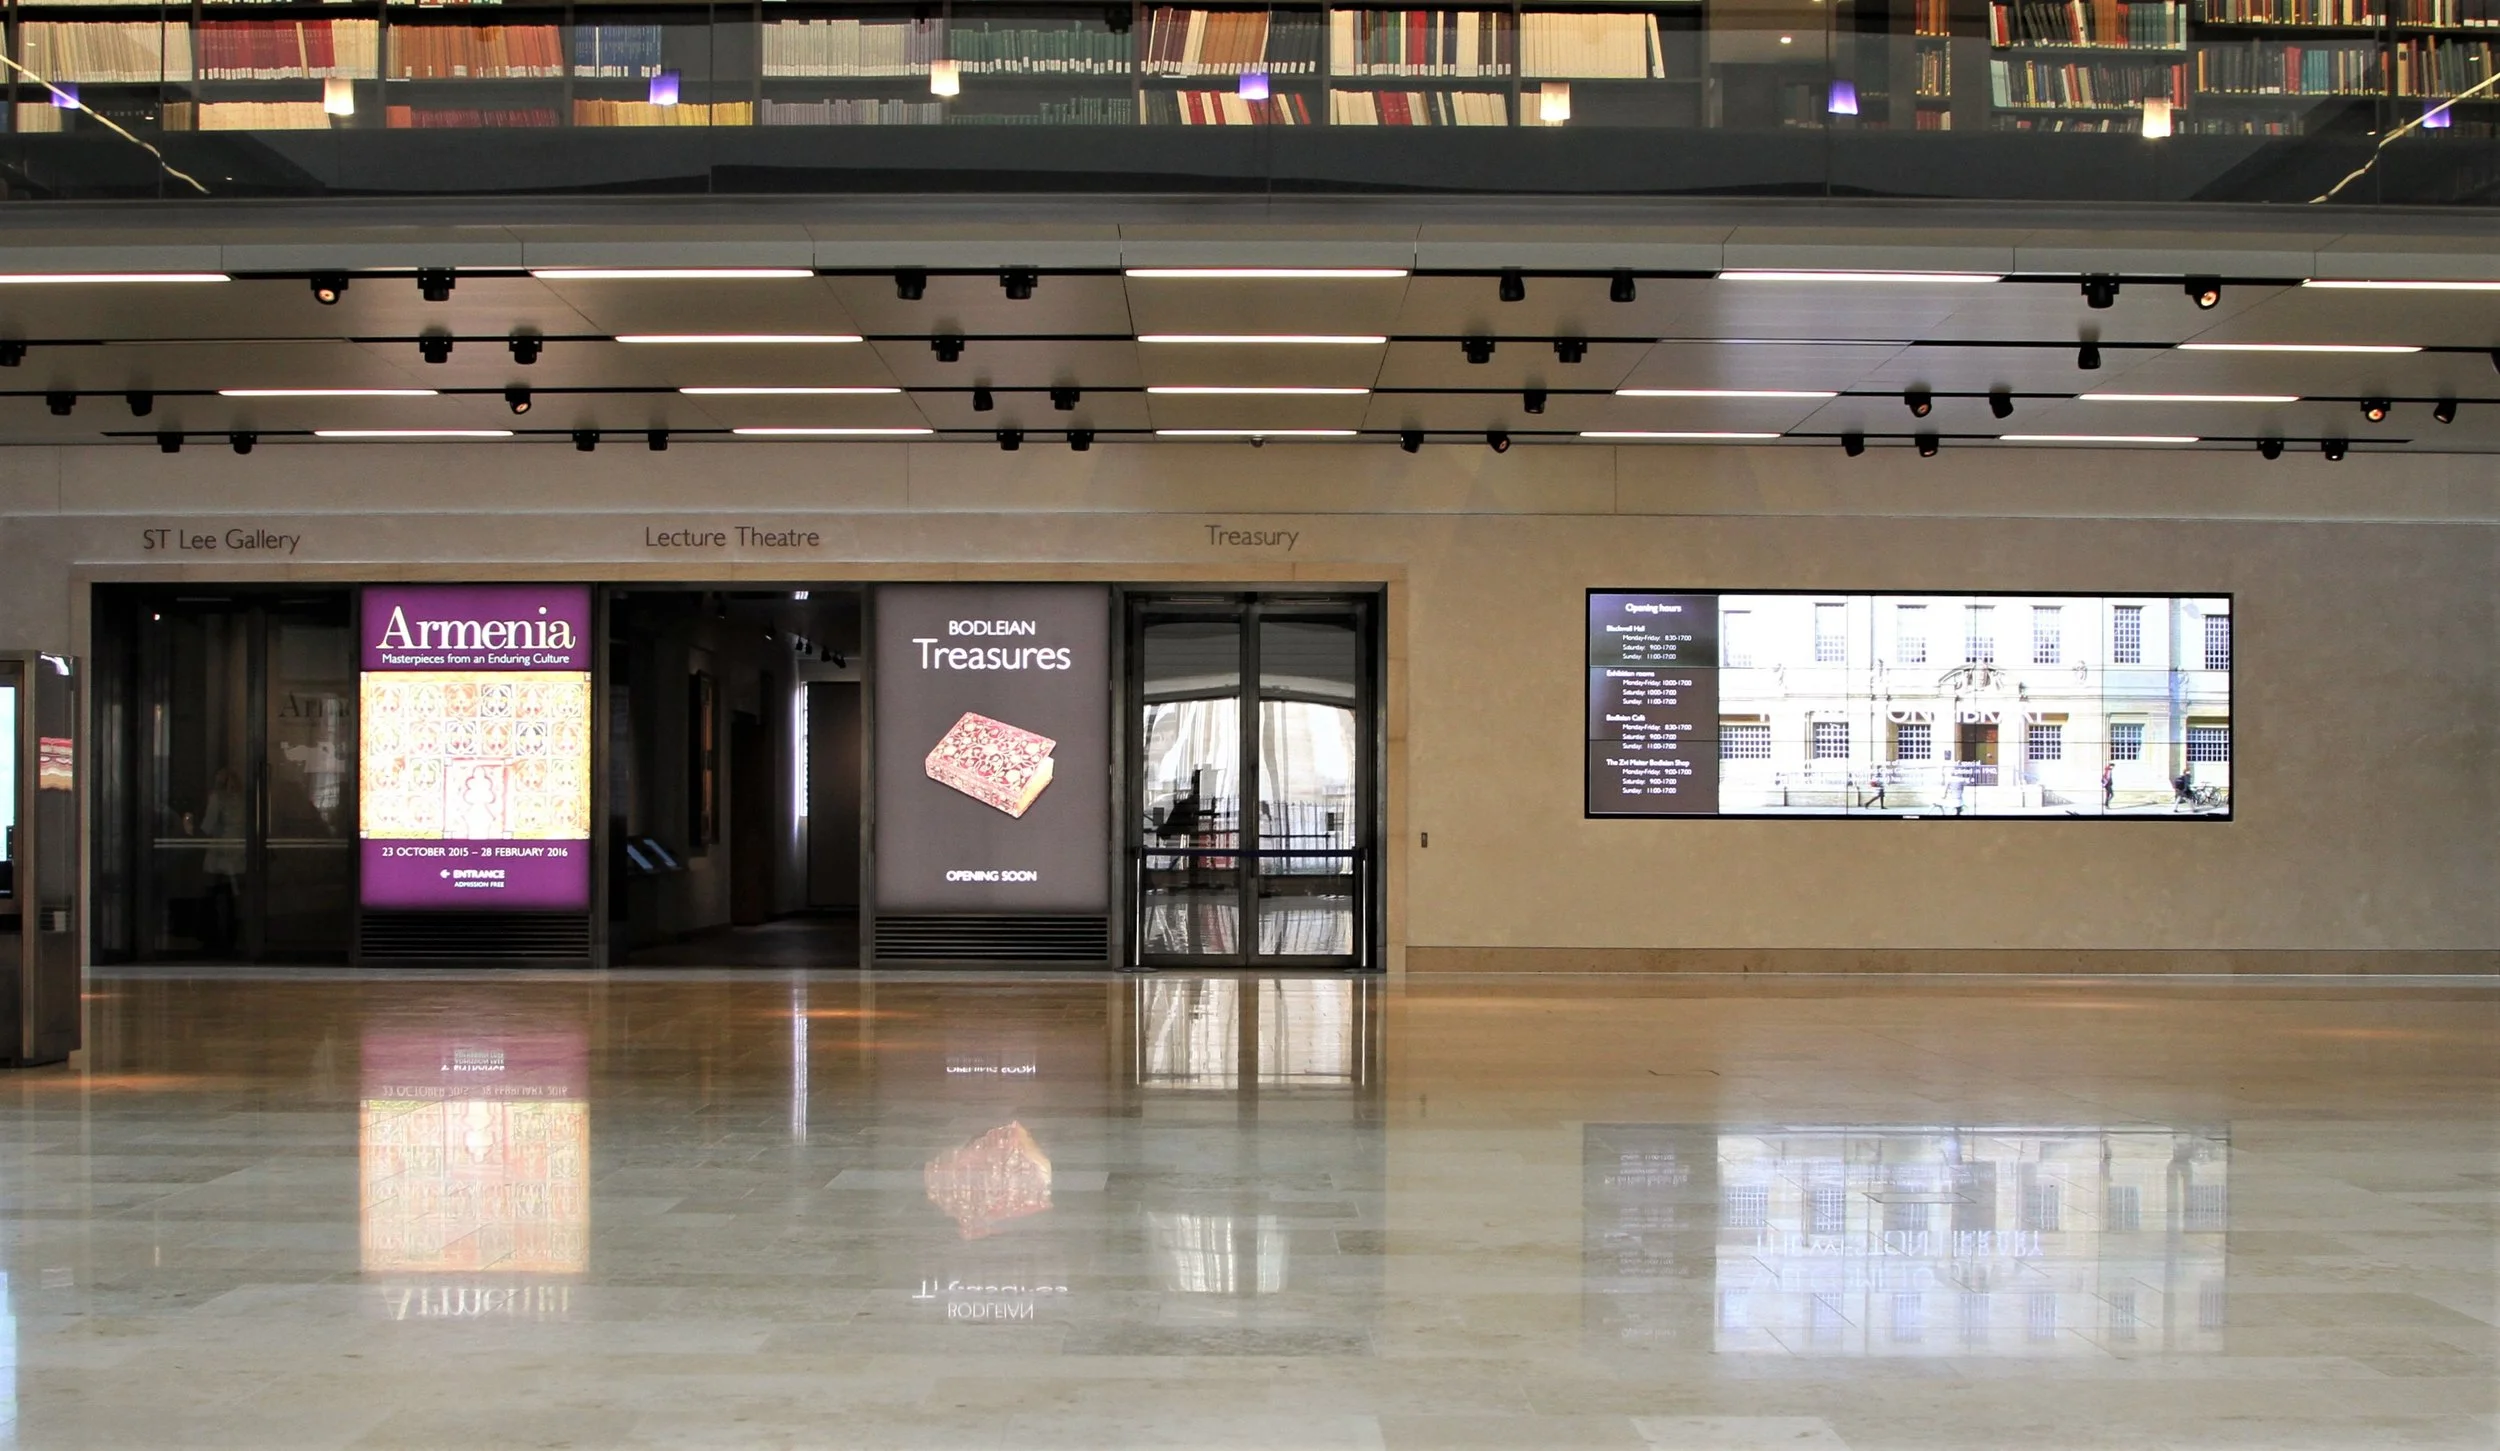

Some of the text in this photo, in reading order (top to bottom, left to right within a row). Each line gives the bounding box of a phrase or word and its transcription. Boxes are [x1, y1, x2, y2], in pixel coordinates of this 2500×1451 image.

[143, 528, 300, 555] ST Lee Gallery
[645, 526, 820, 547] Lecture Theatre
[1204, 524, 1300, 552] Treasury
[1625, 602, 1682, 614] Opening hours
[376, 606, 576, 650] Armenia
[948, 620, 1036, 636] BODLEIAN
[382, 653, 570, 666] Masterpieces from an Enduring Culture
[912, 638, 1072, 670] Treasures
[1674, 760, 1690, 768] Shop
[382, 846, 394, 857] 23
[396, 846, 446, 857] OCTOBER
[448, 846, 469, 857] 2015
[480, 846, 492, 857] 28
[495, 846, 544, 857] FEBRUARY
[547, 846, 568, 857] 2016
[453, 869, 505, 879] ENTRANCE
[946, 870, 1038, 882] OPENING SOON
